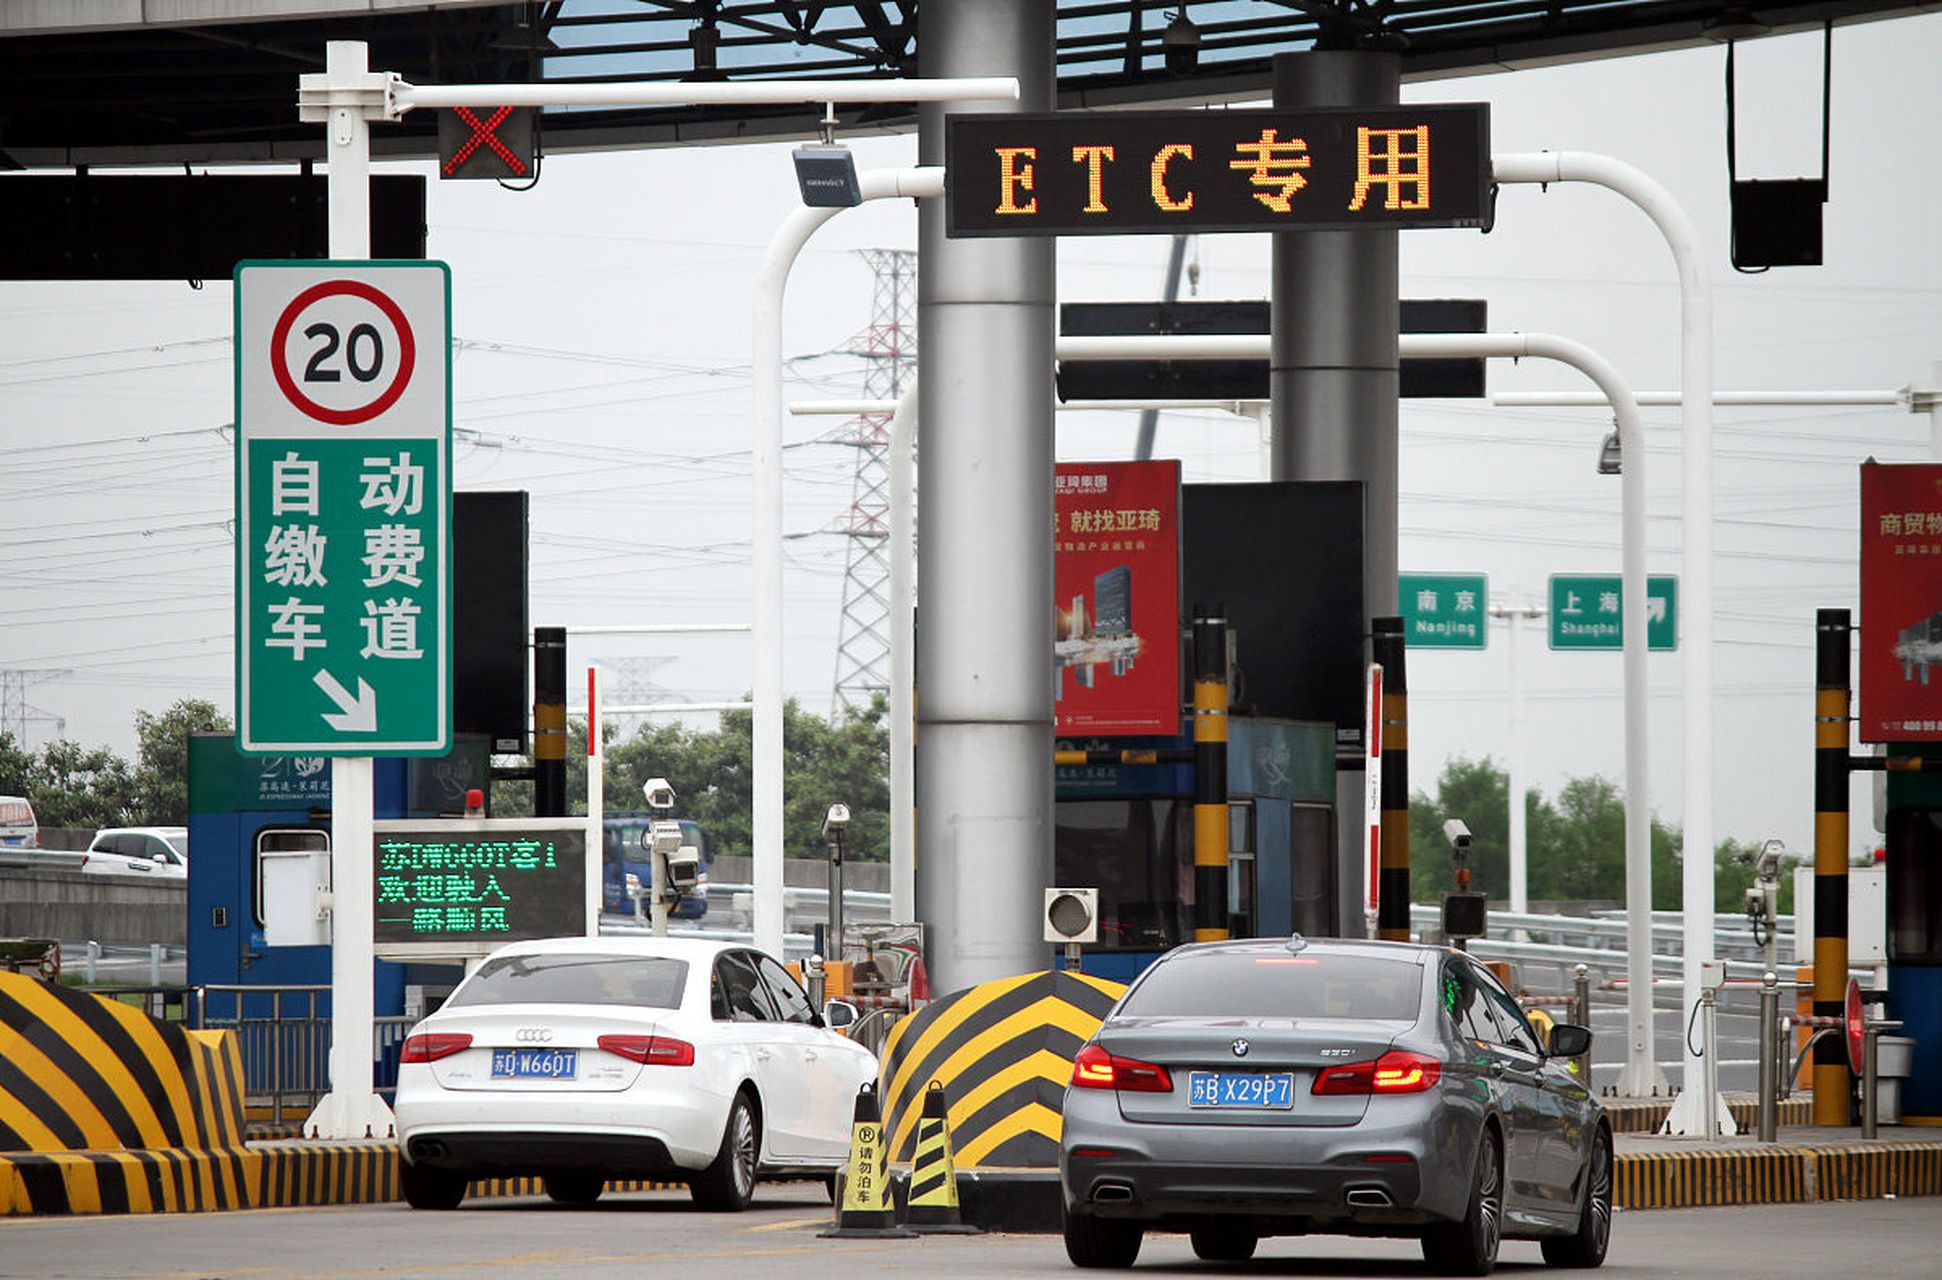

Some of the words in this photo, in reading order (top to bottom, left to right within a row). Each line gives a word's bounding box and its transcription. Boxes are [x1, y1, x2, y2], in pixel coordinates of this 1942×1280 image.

[303, 322, 384, 383] 20
[1417, 589, 1476, 612] 南京
[1561, 590, 1619, 614] 上海
[1416, 620, 1476, 637] Nanjing
[1561, 621, 1619, 637] Shanghai
[857, 1146, 874, 1203] 请勿泊车
